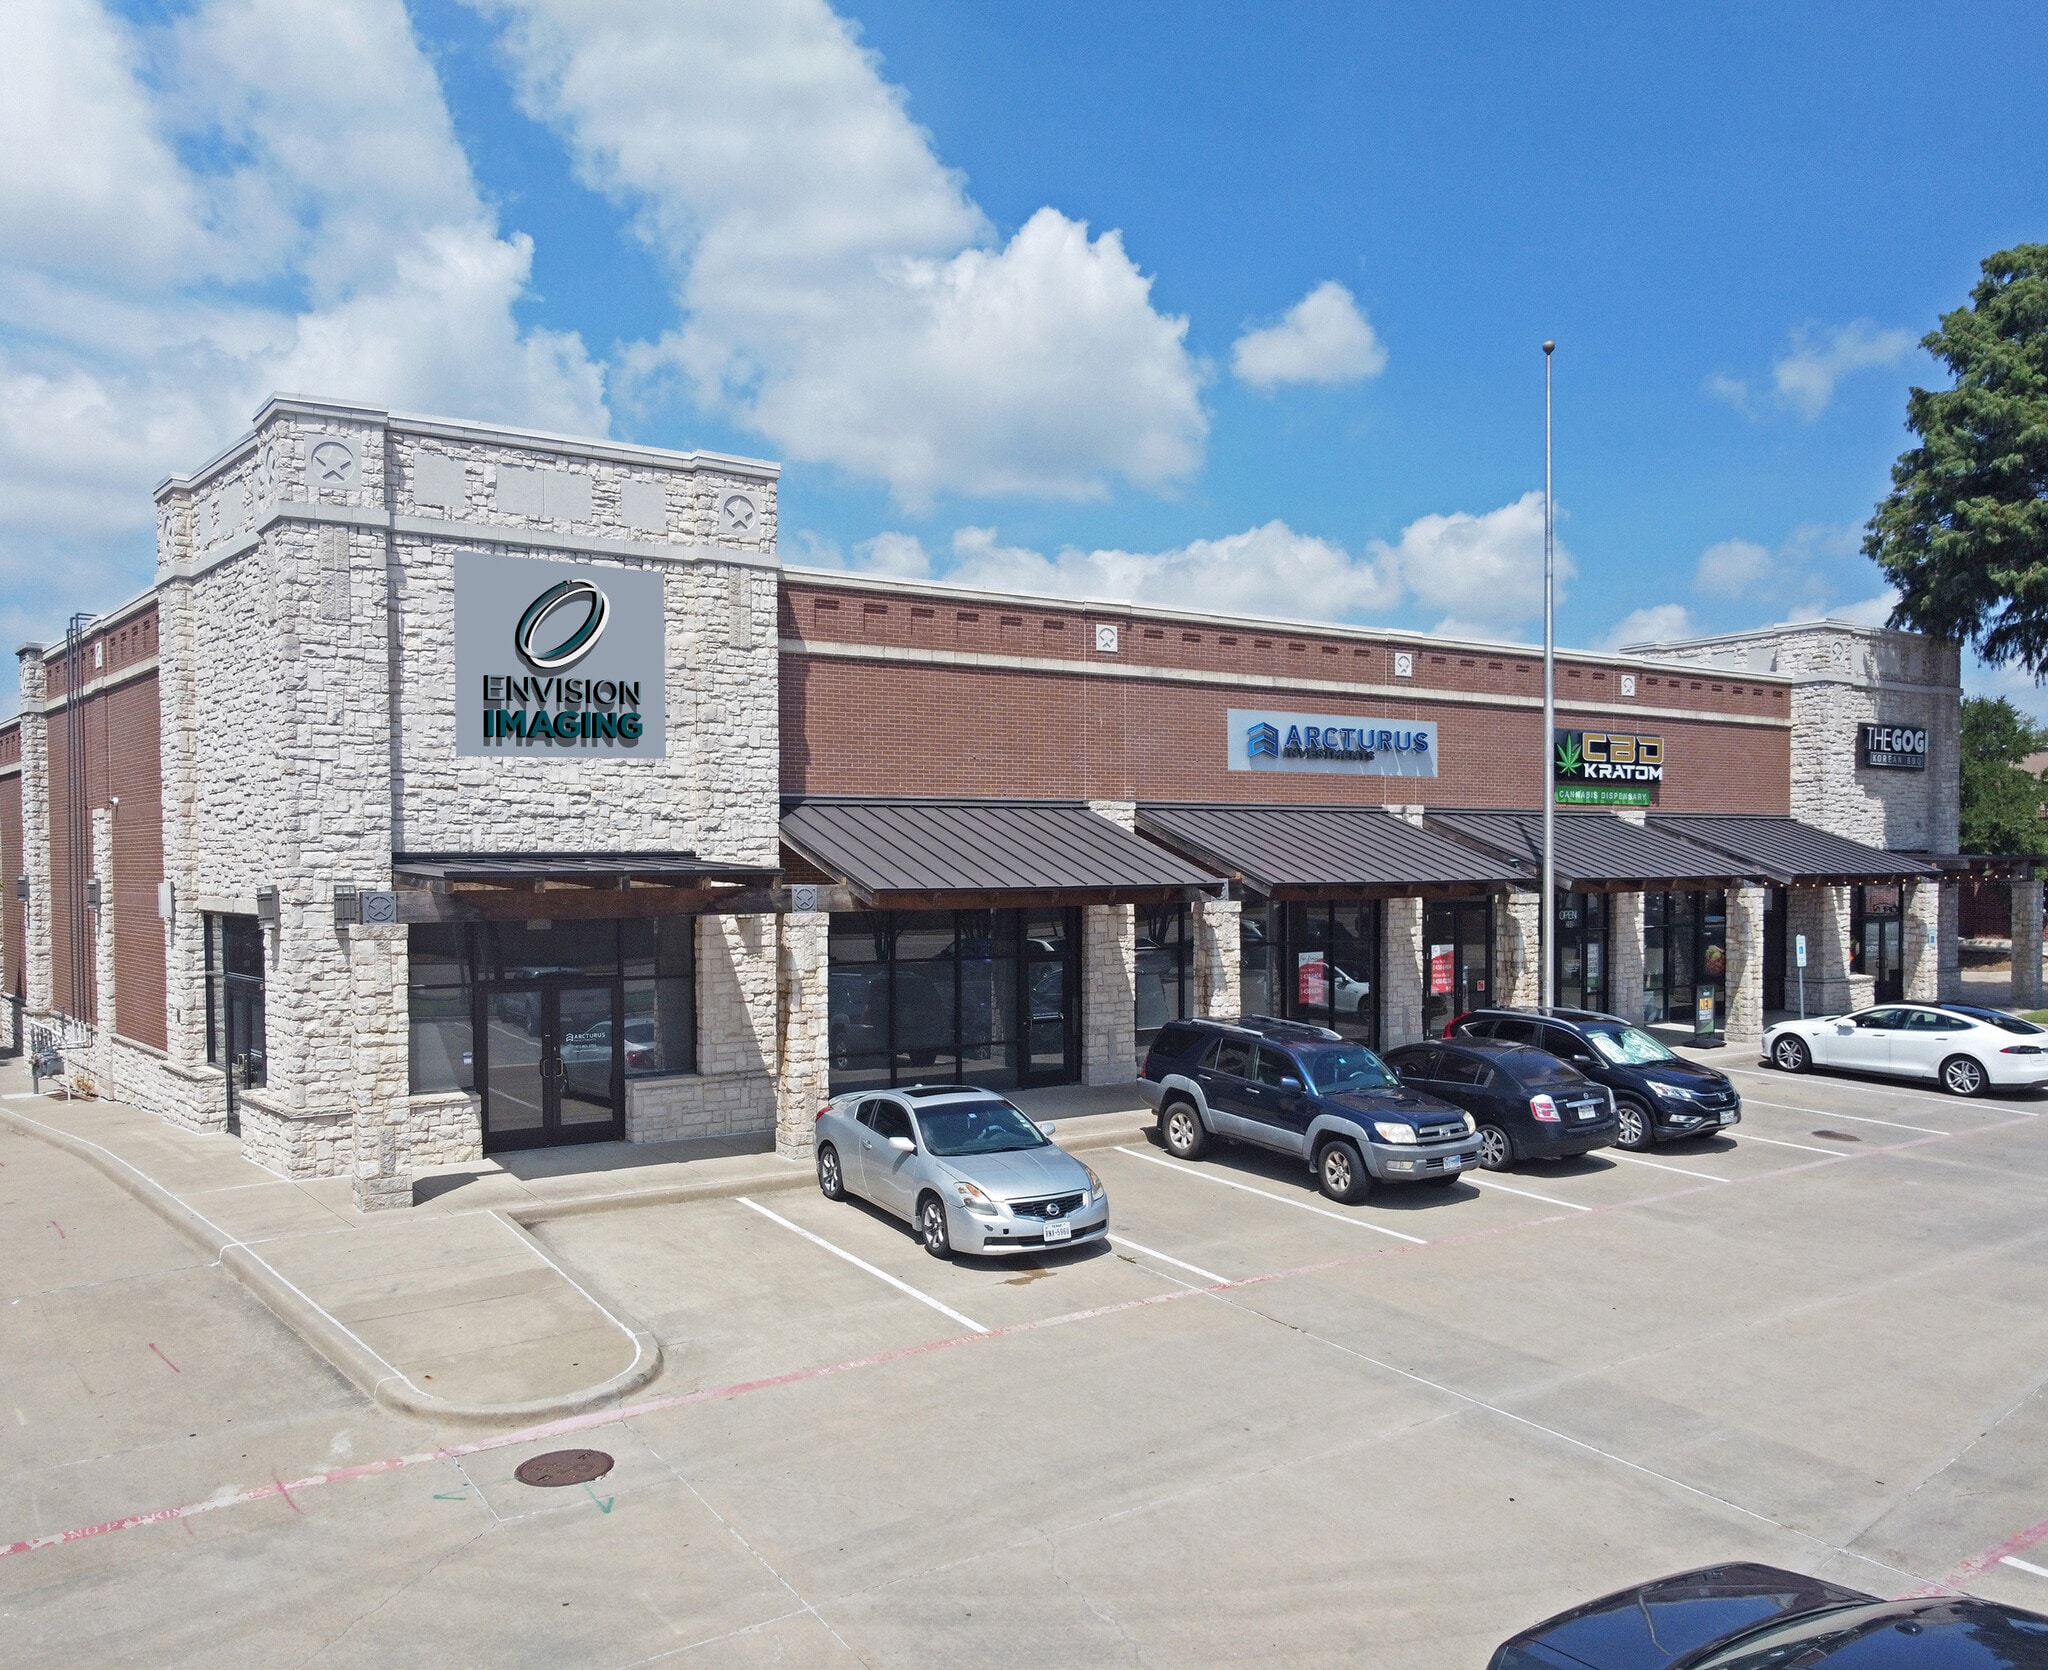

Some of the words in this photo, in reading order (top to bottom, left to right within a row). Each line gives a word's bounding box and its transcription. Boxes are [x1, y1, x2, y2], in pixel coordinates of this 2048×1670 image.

[483, 675, 641, 705] ENVISION
[483, 709, 643, 738] IMAGING
[1284, 725, 1429, 753] ARCTURUS
[1283, 747, 1376, 761] INVESTMENTS
[1582, 732, 1665, 765] CBD
[1872, 754, 1902, 764] KOREAN
[1583, 763, 1663, 781] KRATOM
[1559, 790, 1598, 799] CANNABIS
[1601, 791, 1647, 801] DISPENSARY
[1559, 910, 1577, 920] OPEN
